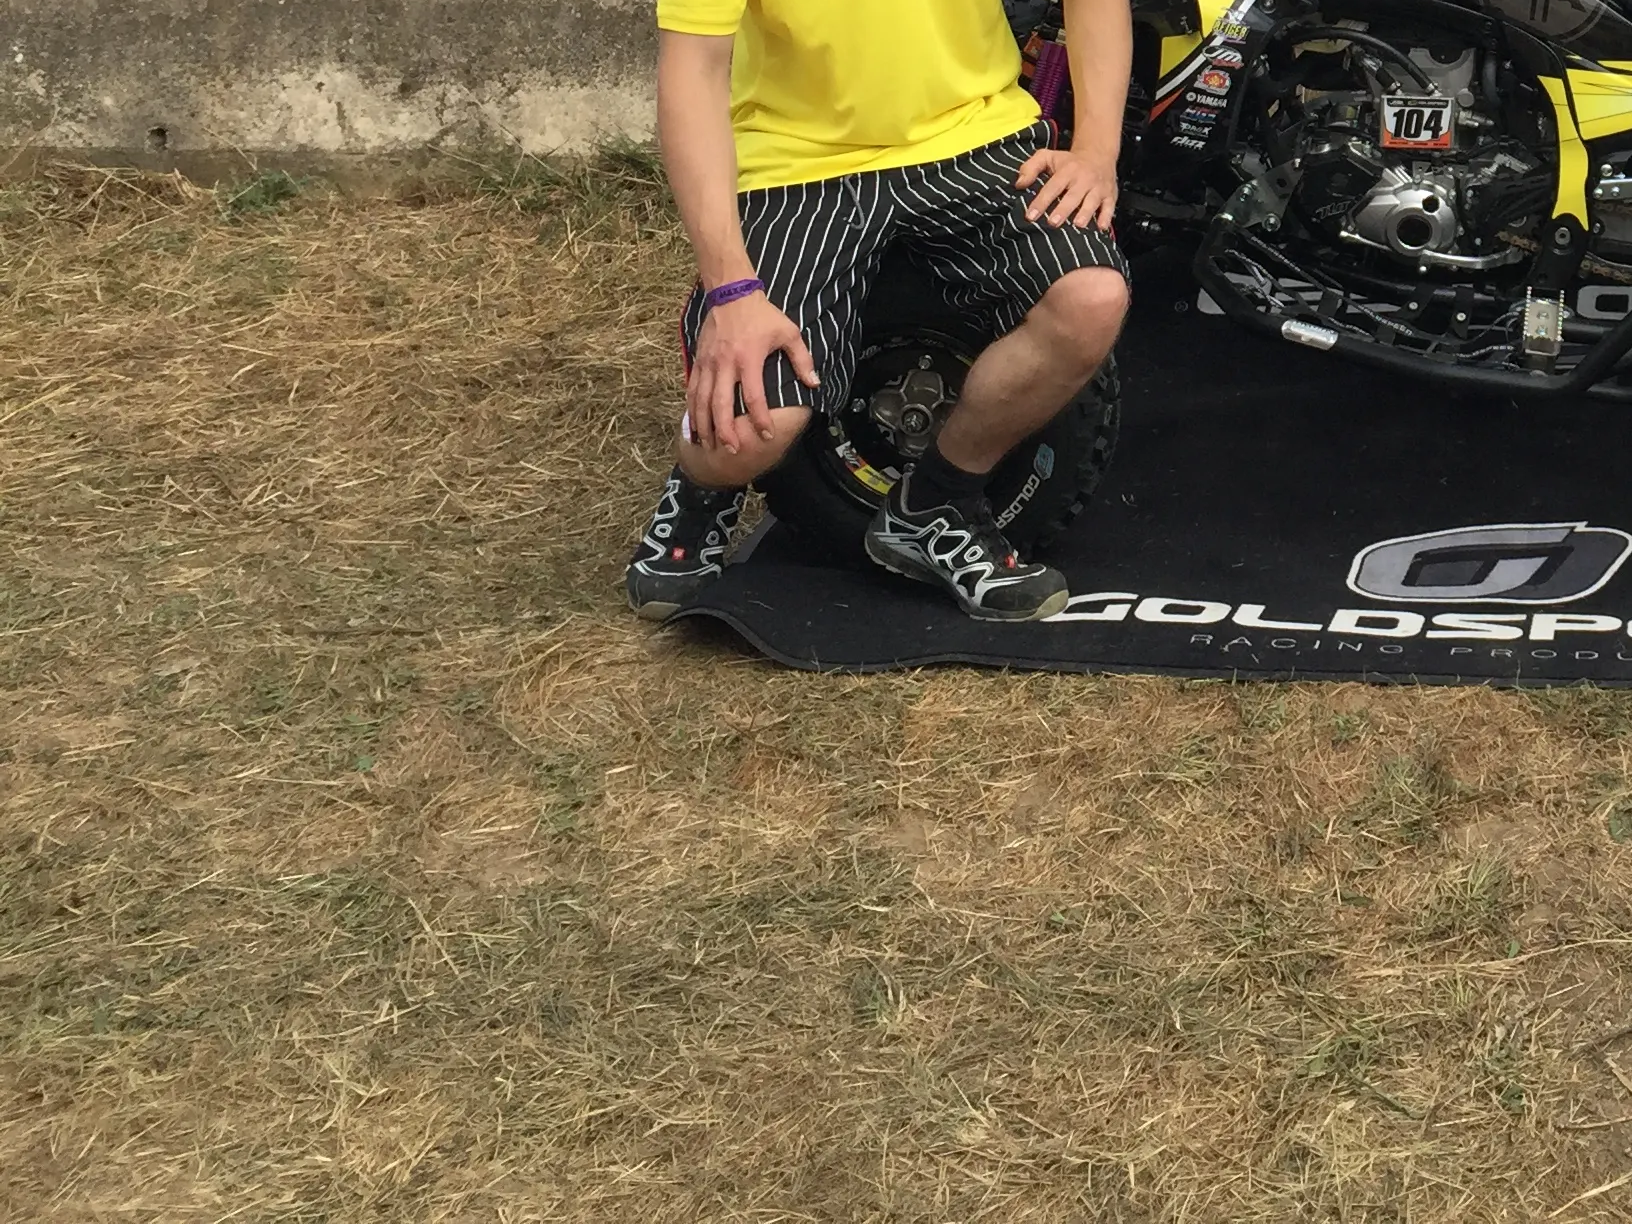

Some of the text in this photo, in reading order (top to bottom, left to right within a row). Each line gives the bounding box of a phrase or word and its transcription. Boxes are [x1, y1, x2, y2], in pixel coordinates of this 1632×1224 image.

[1392, 108, 1444, 139] 104
[996, 473, 1041, 529] GOLDSP
[1189, 633, 1405, 656] RACING
